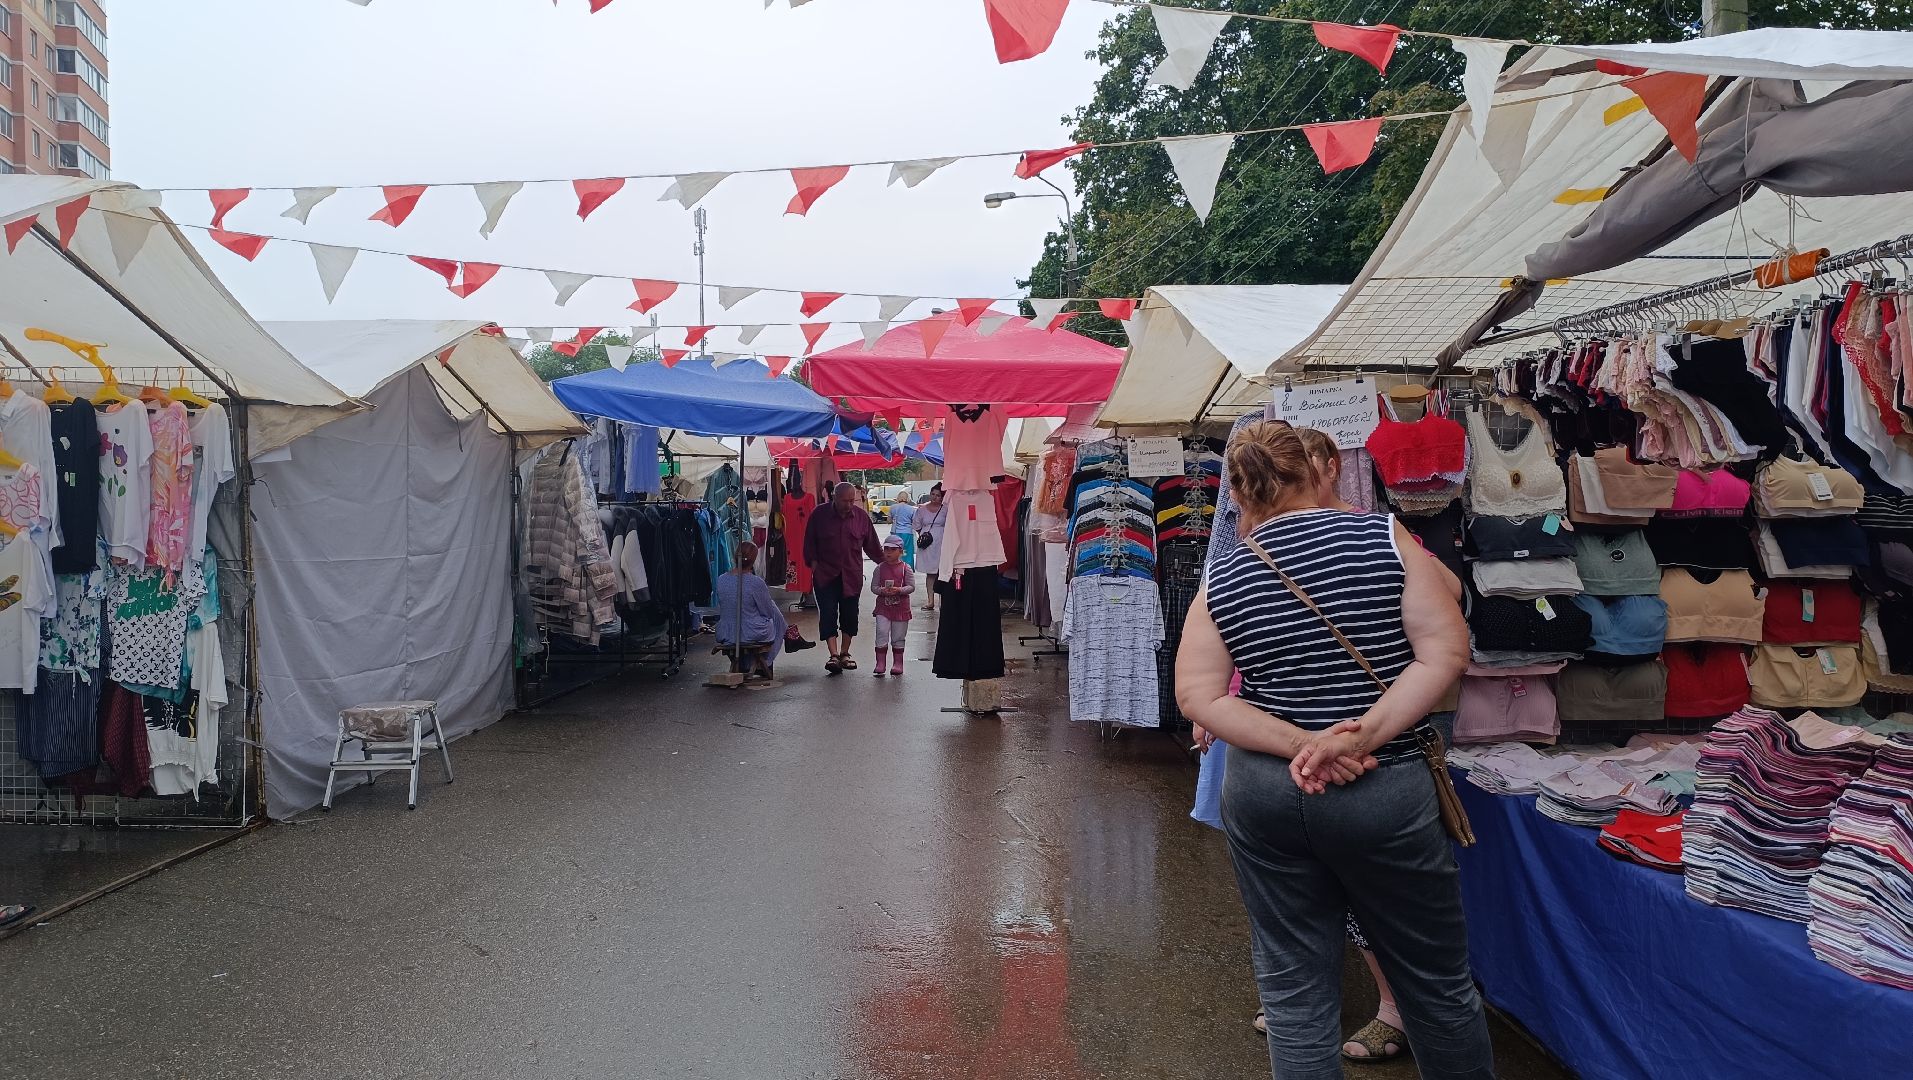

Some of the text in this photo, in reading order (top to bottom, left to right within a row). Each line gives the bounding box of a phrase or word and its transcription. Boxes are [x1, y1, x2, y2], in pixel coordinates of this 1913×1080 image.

[1309, 386, 1343, 395] ЯРМАРКА
[1662, 508, 1744, 518] Calvin Klein
